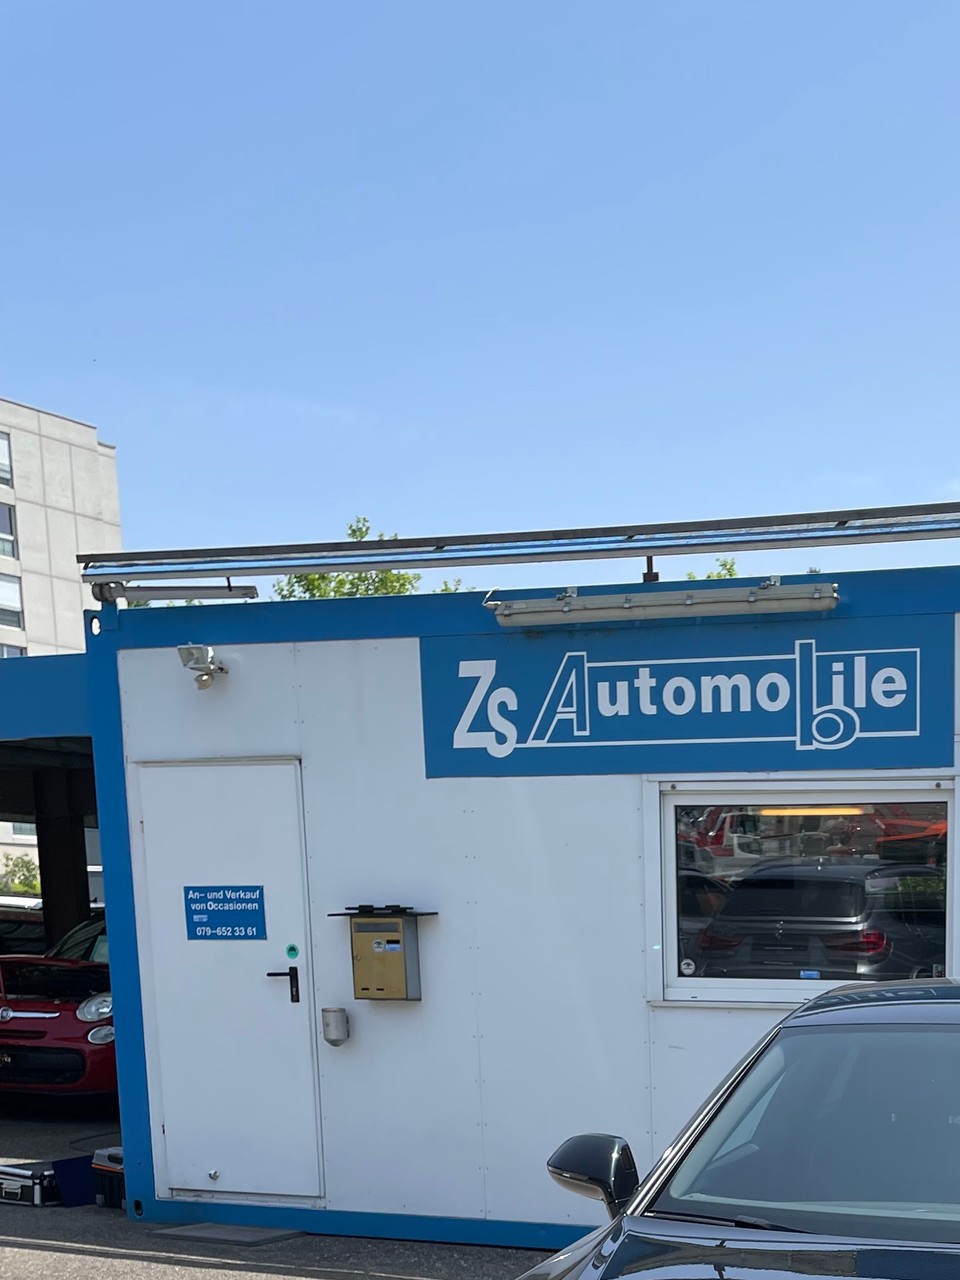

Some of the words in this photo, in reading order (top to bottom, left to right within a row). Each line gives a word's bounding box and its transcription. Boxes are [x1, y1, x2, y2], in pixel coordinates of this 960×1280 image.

[526, 639, 909, 751] Automobile
[207, 890, 224, 899] und
[225, 889, 260, 899] Verkauf
[190, 902, 206, 910] von
[207, 901, 259, 910] Occasionen
[196, 926, 232, 936] 079-652
[234, 926, 245, 936] 33
[247, 926, 256, 936] 61
